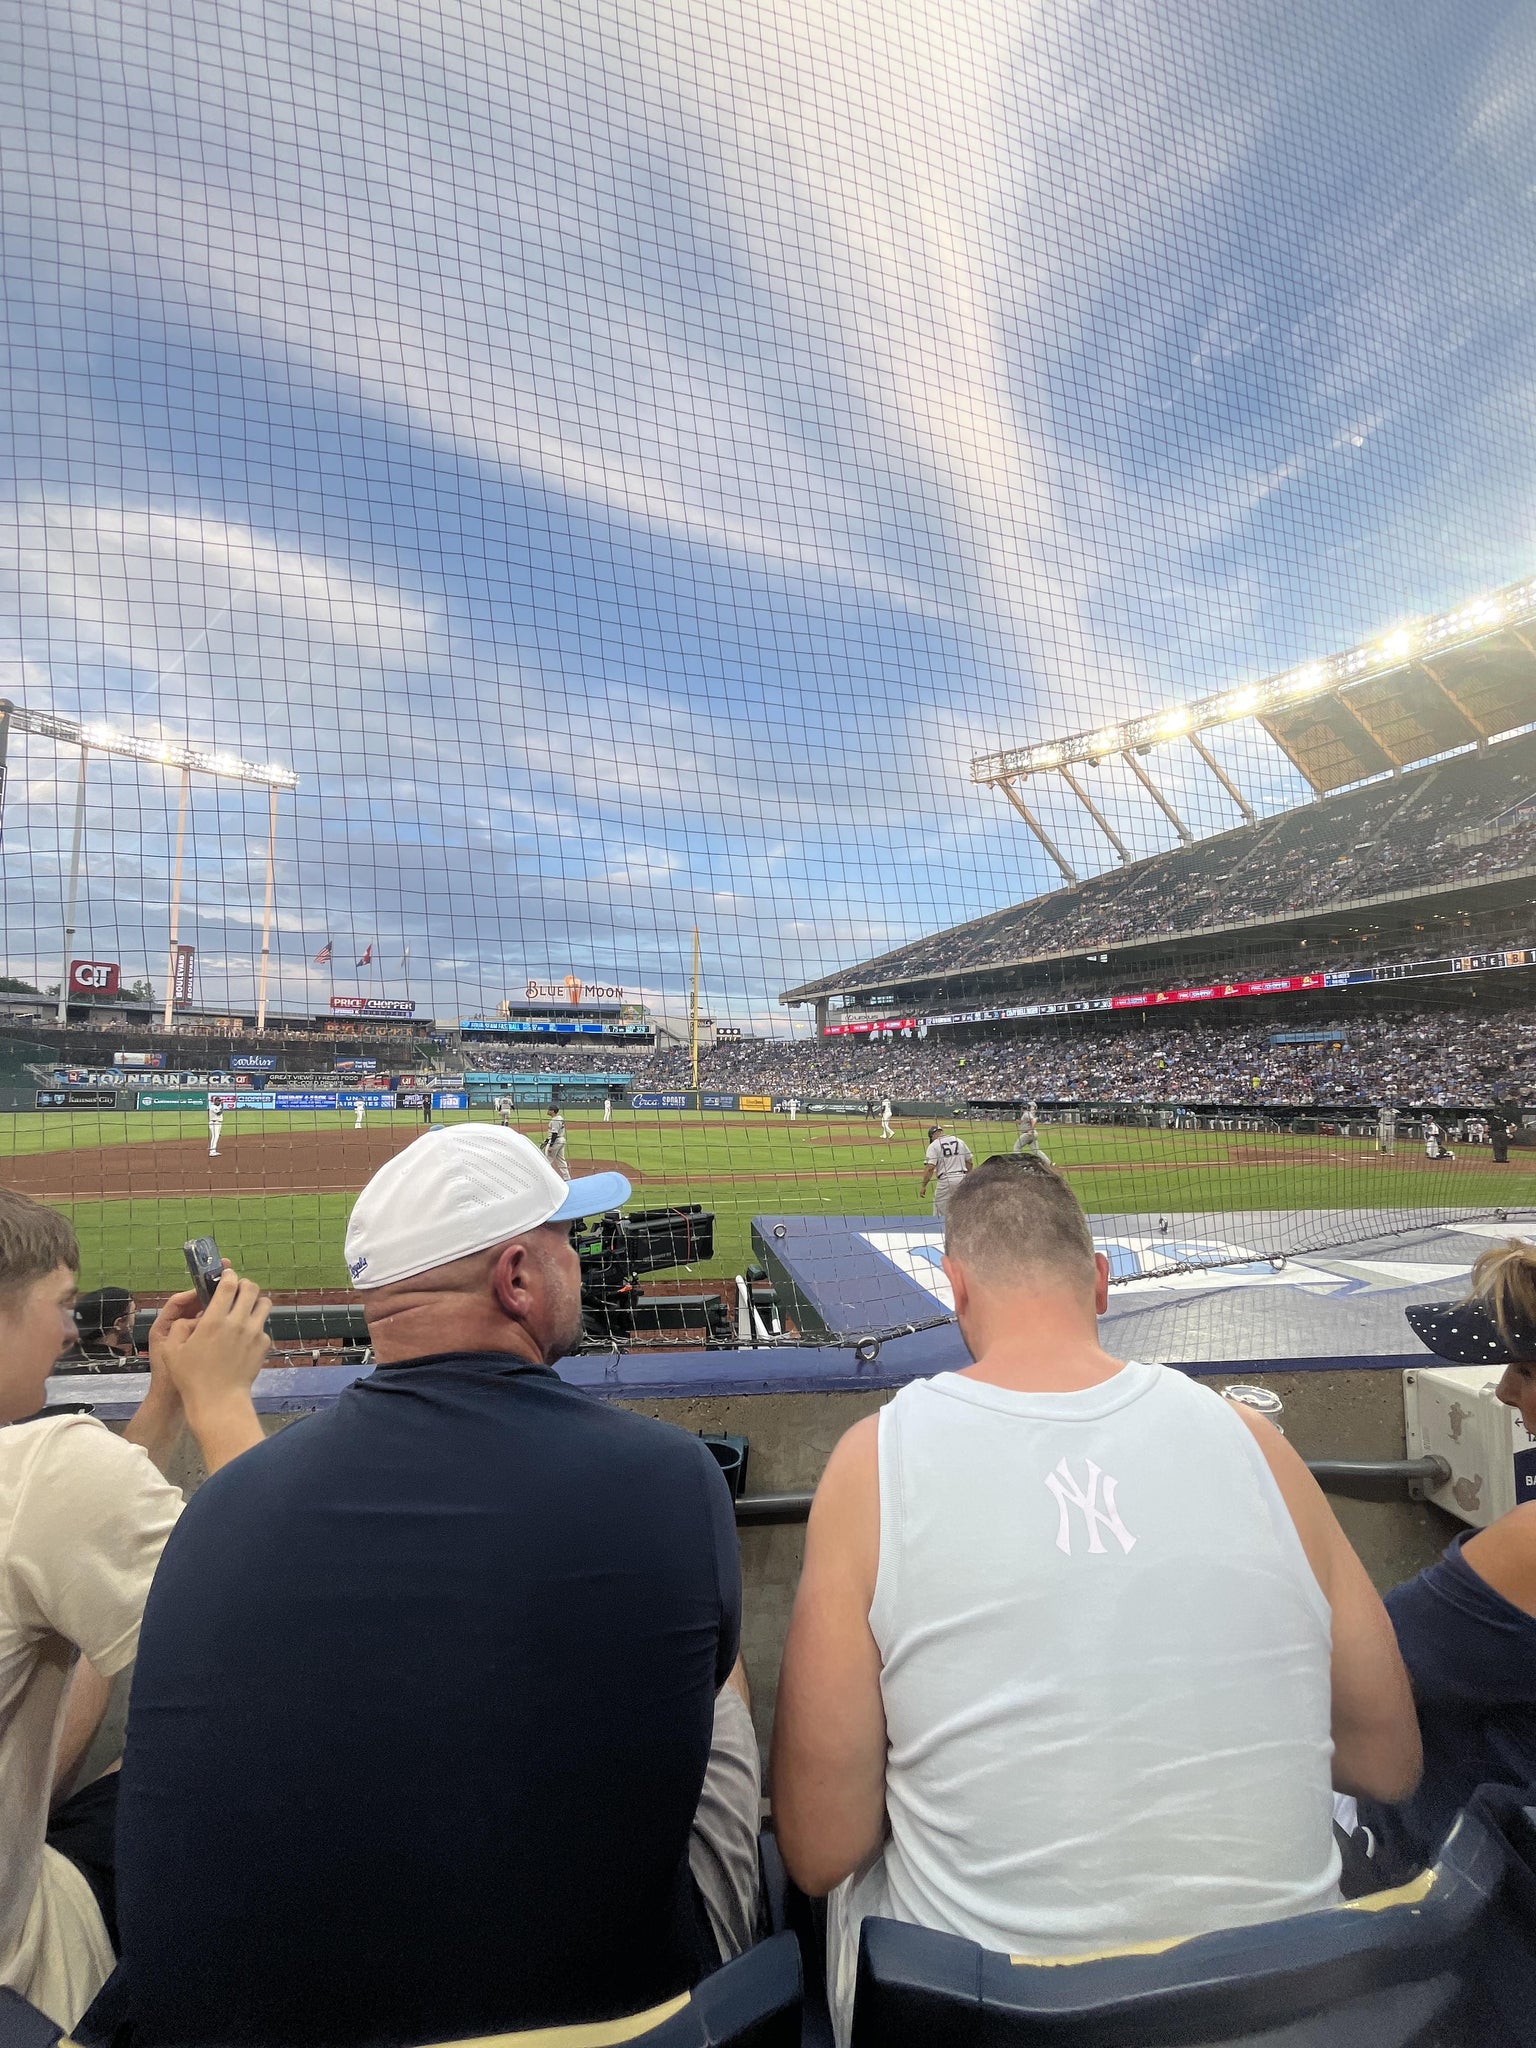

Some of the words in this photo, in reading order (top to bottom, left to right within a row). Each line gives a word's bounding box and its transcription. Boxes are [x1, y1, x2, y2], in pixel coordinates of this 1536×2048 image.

[75, 964, 112, 988] QT
[176, 954, 185, 998] BOULEVARD
[525, 980, 565, 999] BLUE
[584, 984, 624, 998] MOON
[334, 998, 362, 1008] PRICE
[367, 1000, 412, 1010] CHOPPER
[89, 1073, 180, 1085] FOUNTAIN
[187, 1075, 231, 1085] DECK
[98, 1096, 113, 1104] City
[661, 1095, 686, 1106] SPORTS
[941, 1140, 959, 1158] 67
[1044, 1456, 1137, 1556] NY
